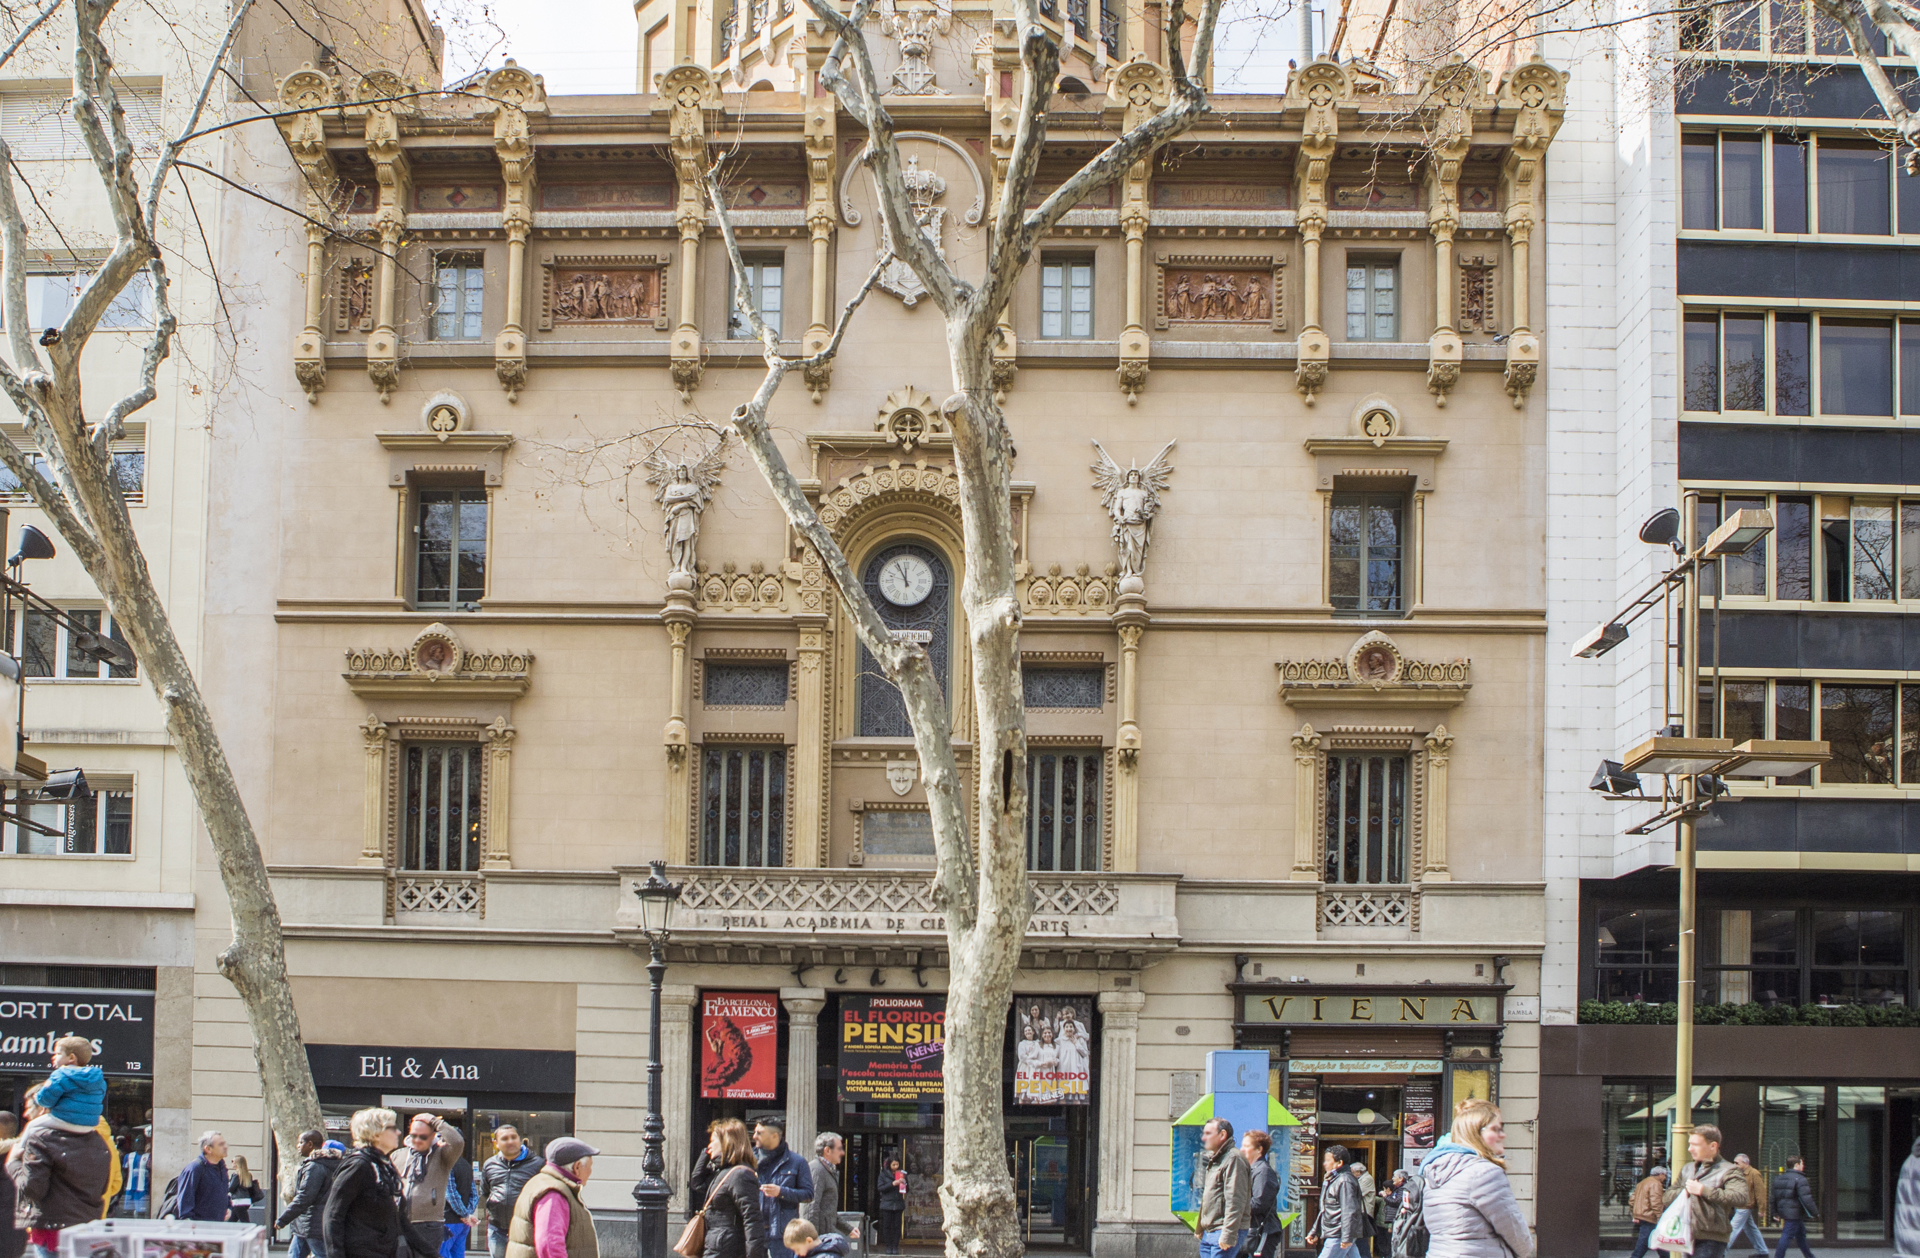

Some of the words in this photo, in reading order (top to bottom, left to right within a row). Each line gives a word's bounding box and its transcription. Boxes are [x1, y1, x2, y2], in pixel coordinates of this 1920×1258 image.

[67, 804, 76, 851] congresses
[722, 916, 768, 927] REIAL
[784, 915, 872, 929] ACADÈMIA
[886, 918, 905, 929] DE
[1028, 920, 1069, 932] ARTS
[791, 952, 928, 988] teat
[704, 1000, 777, 1017] FLAMENCO
[717, 997, 767, 1006] BARCELONA
[873, 999, 923, 1007] POLIORAMA
[1261, 996, 1480, 1021] VIENA
[58, 1003, 143, 1021] TOTAL
[844, 1010, 862, 1022] EL
[868, 1011, 945, 1023] FLORIDO
[844, 1023, 945, 1044] PENSIL
[908, 1042, 945, 1058] NENES
[126, 1061, 141, 1069] 113
[360, 1056, 393, 1078] Eli
[400, 1057, 423, 1079] &
[430, 1058, 480, 1080] Ana
[869, 1061, 908, 1070] Memòria
[911, 1062, 922, 1070] de
[1381, 1060, 1408, 1071] Fast
[1411, 1061, 1439, 1073] food
[842, 1068, 875, 1077] l'escola
[878, 1069, 943, 1078] nacionalcatòlic
[1033, 1072, 1088, 1080] FLORIDO
[1016, 1080, 1087, 1094] PENSIL
